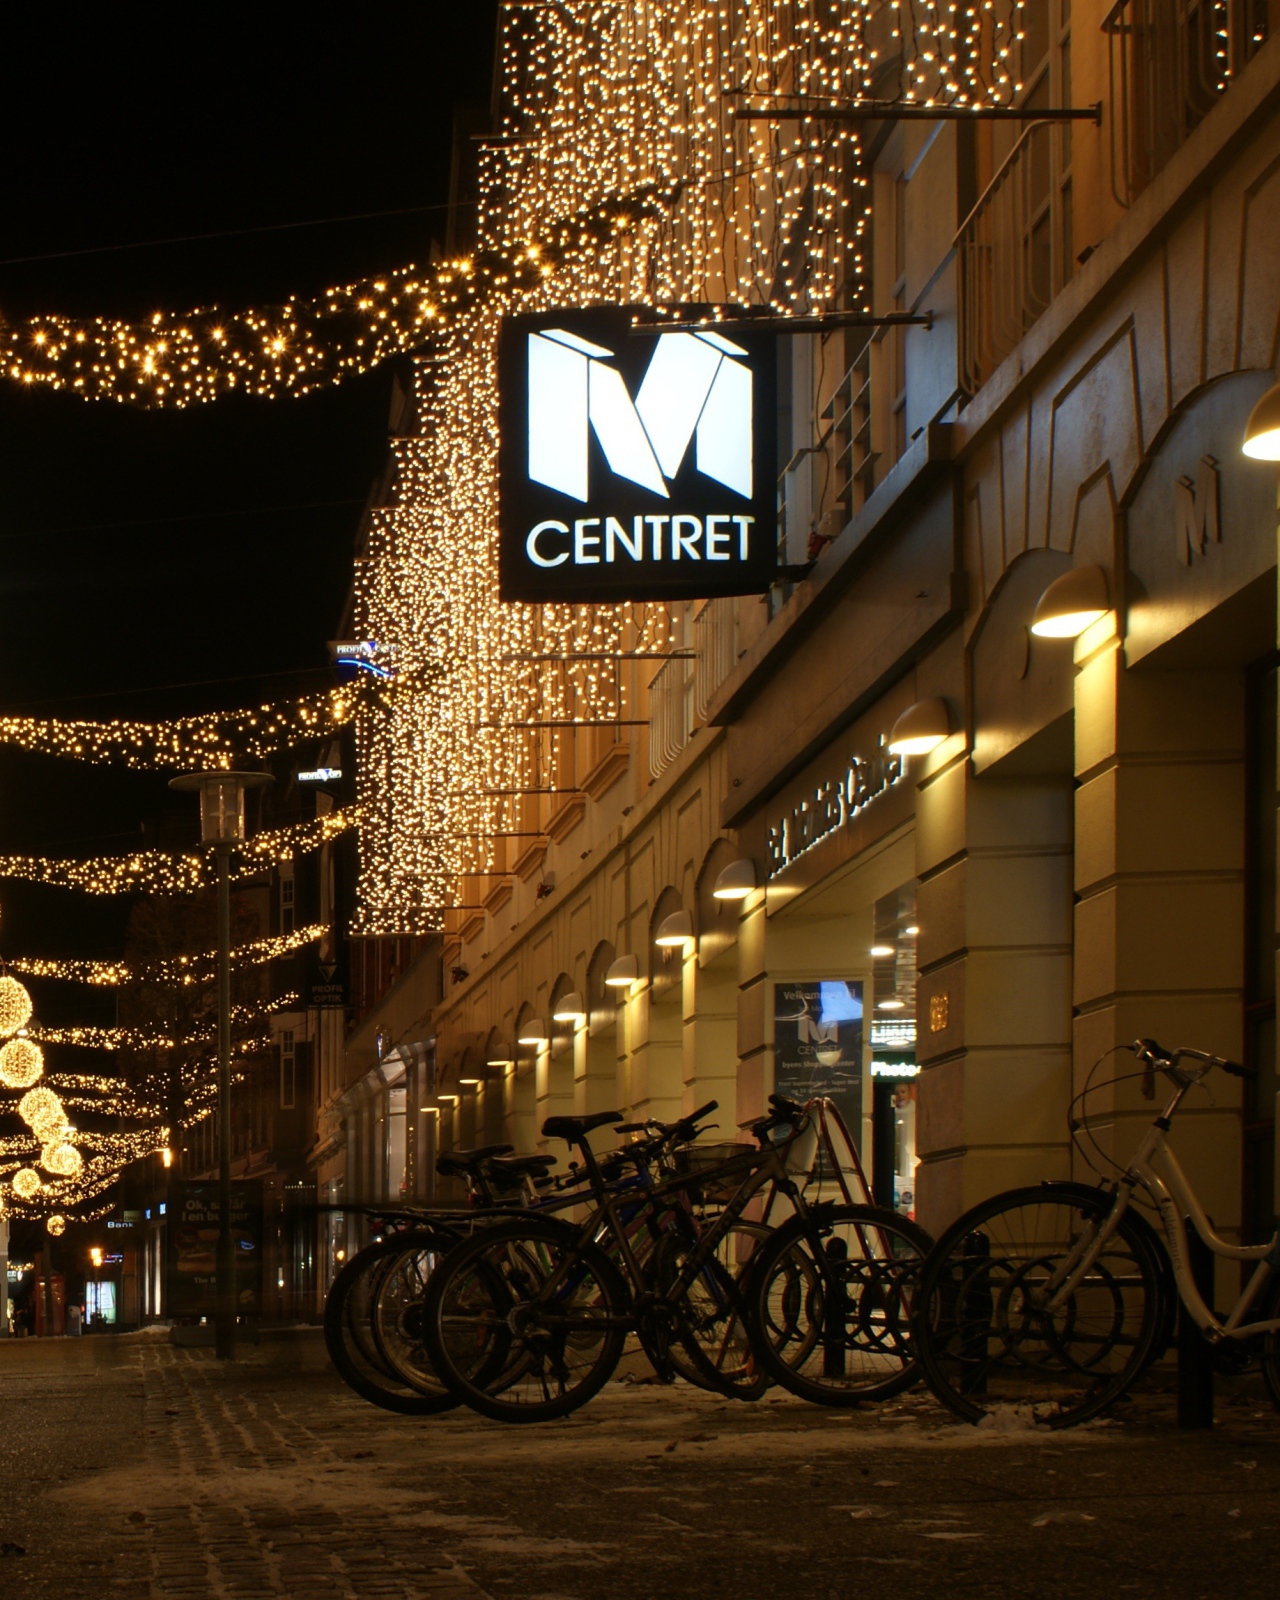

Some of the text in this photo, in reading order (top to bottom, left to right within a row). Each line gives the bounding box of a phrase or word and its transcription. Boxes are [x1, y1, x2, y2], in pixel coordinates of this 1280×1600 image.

[525, 514, 756, 568] CENTRET
[311, 984, 344, 993] PROFIL
[313, 994, 342, 1003] OPTIK
[185, 1200, 208, 1212] Ok,
[188, 1213, 204, 1222] en
[207, 1211, 249, 1223] buger
[107, 1221, 134, 1229] Bank
